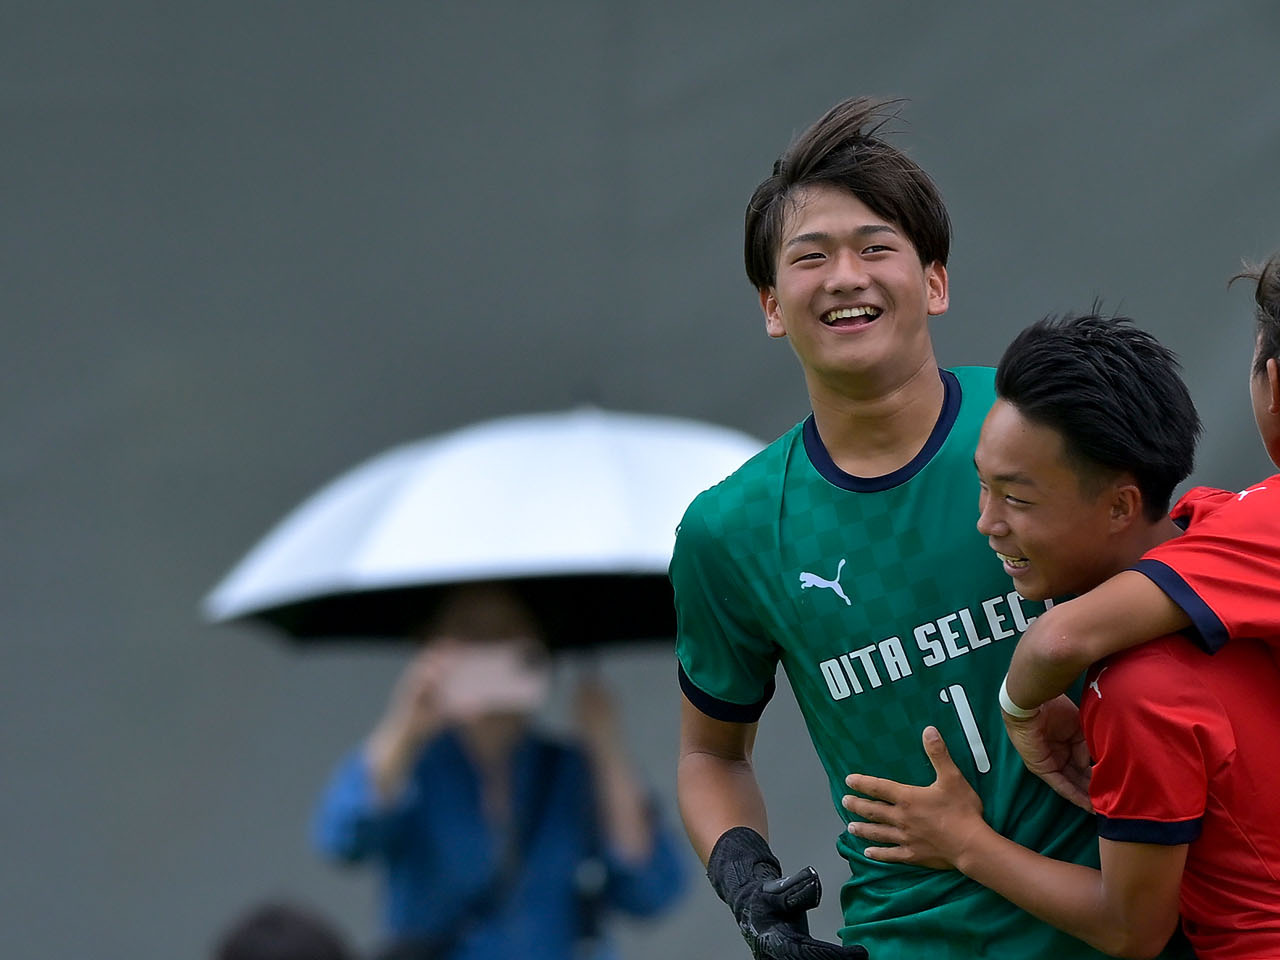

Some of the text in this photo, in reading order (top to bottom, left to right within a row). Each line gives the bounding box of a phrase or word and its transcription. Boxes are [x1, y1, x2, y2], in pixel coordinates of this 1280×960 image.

[819, 590, 1054, 701] OITA SELEC
[939, 683, 991, 774] 1
